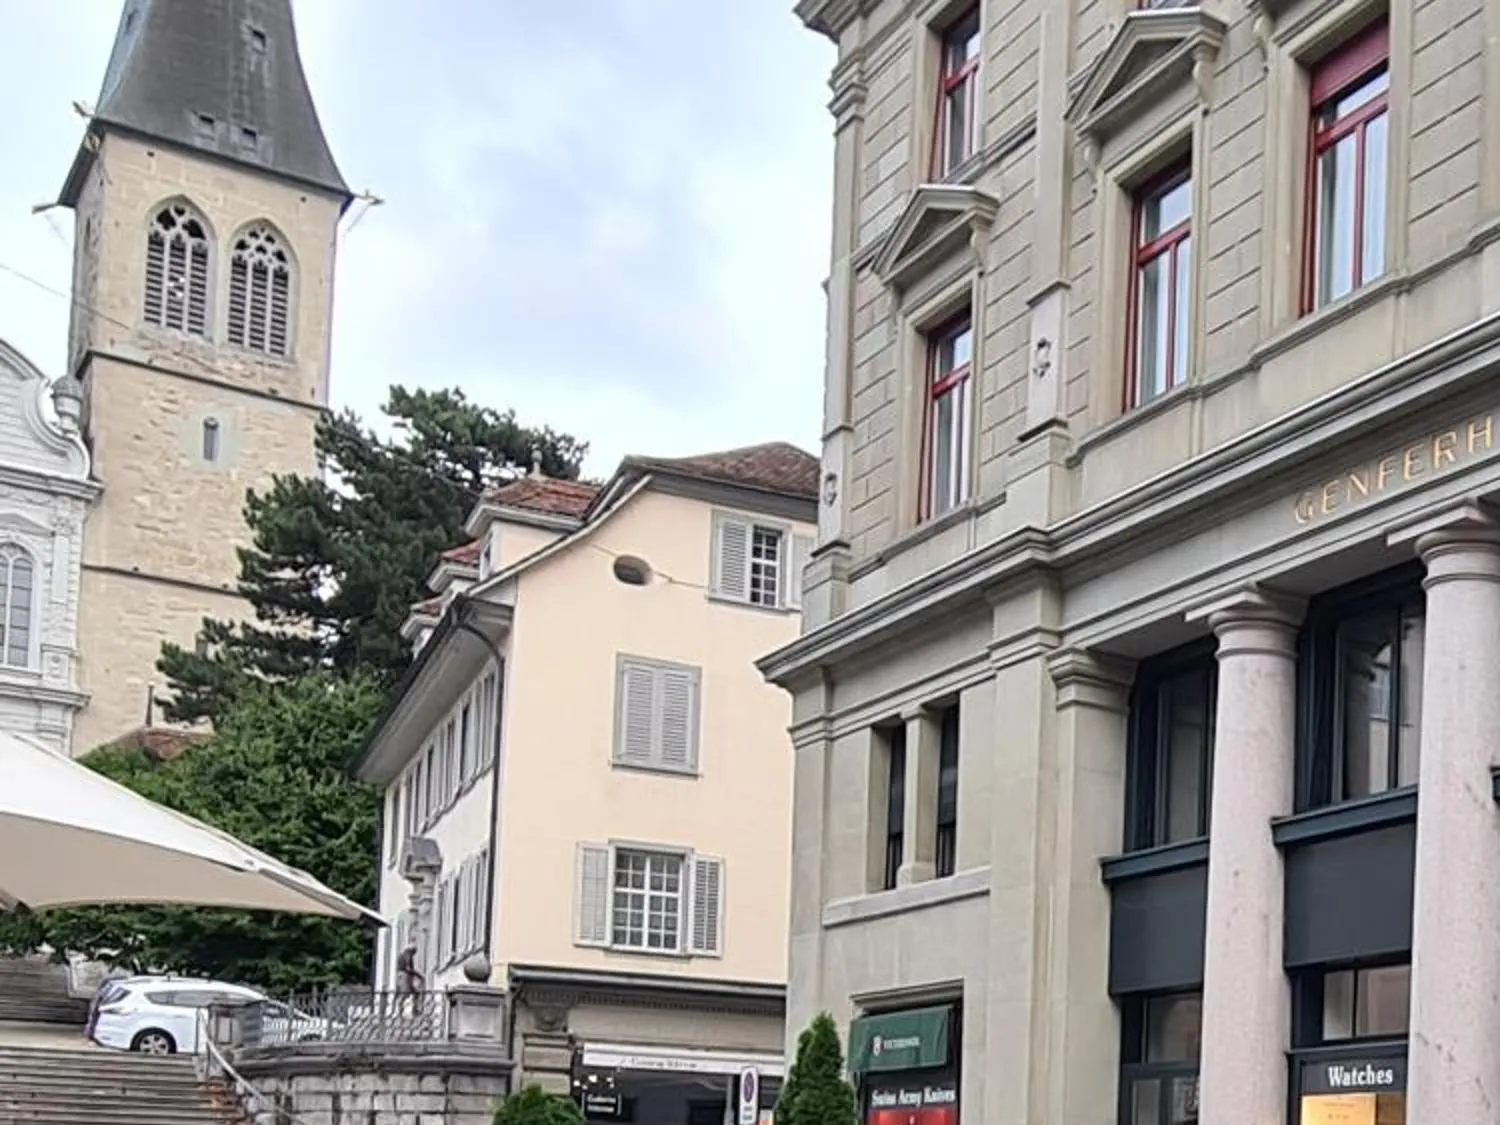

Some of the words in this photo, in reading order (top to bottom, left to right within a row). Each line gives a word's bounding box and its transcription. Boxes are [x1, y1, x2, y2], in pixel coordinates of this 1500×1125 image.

[1328, 1064, 1394, 1088] Watches
[898, 1087, 923, 1109] Army
[924, 1085, 956, 1104] Knives
